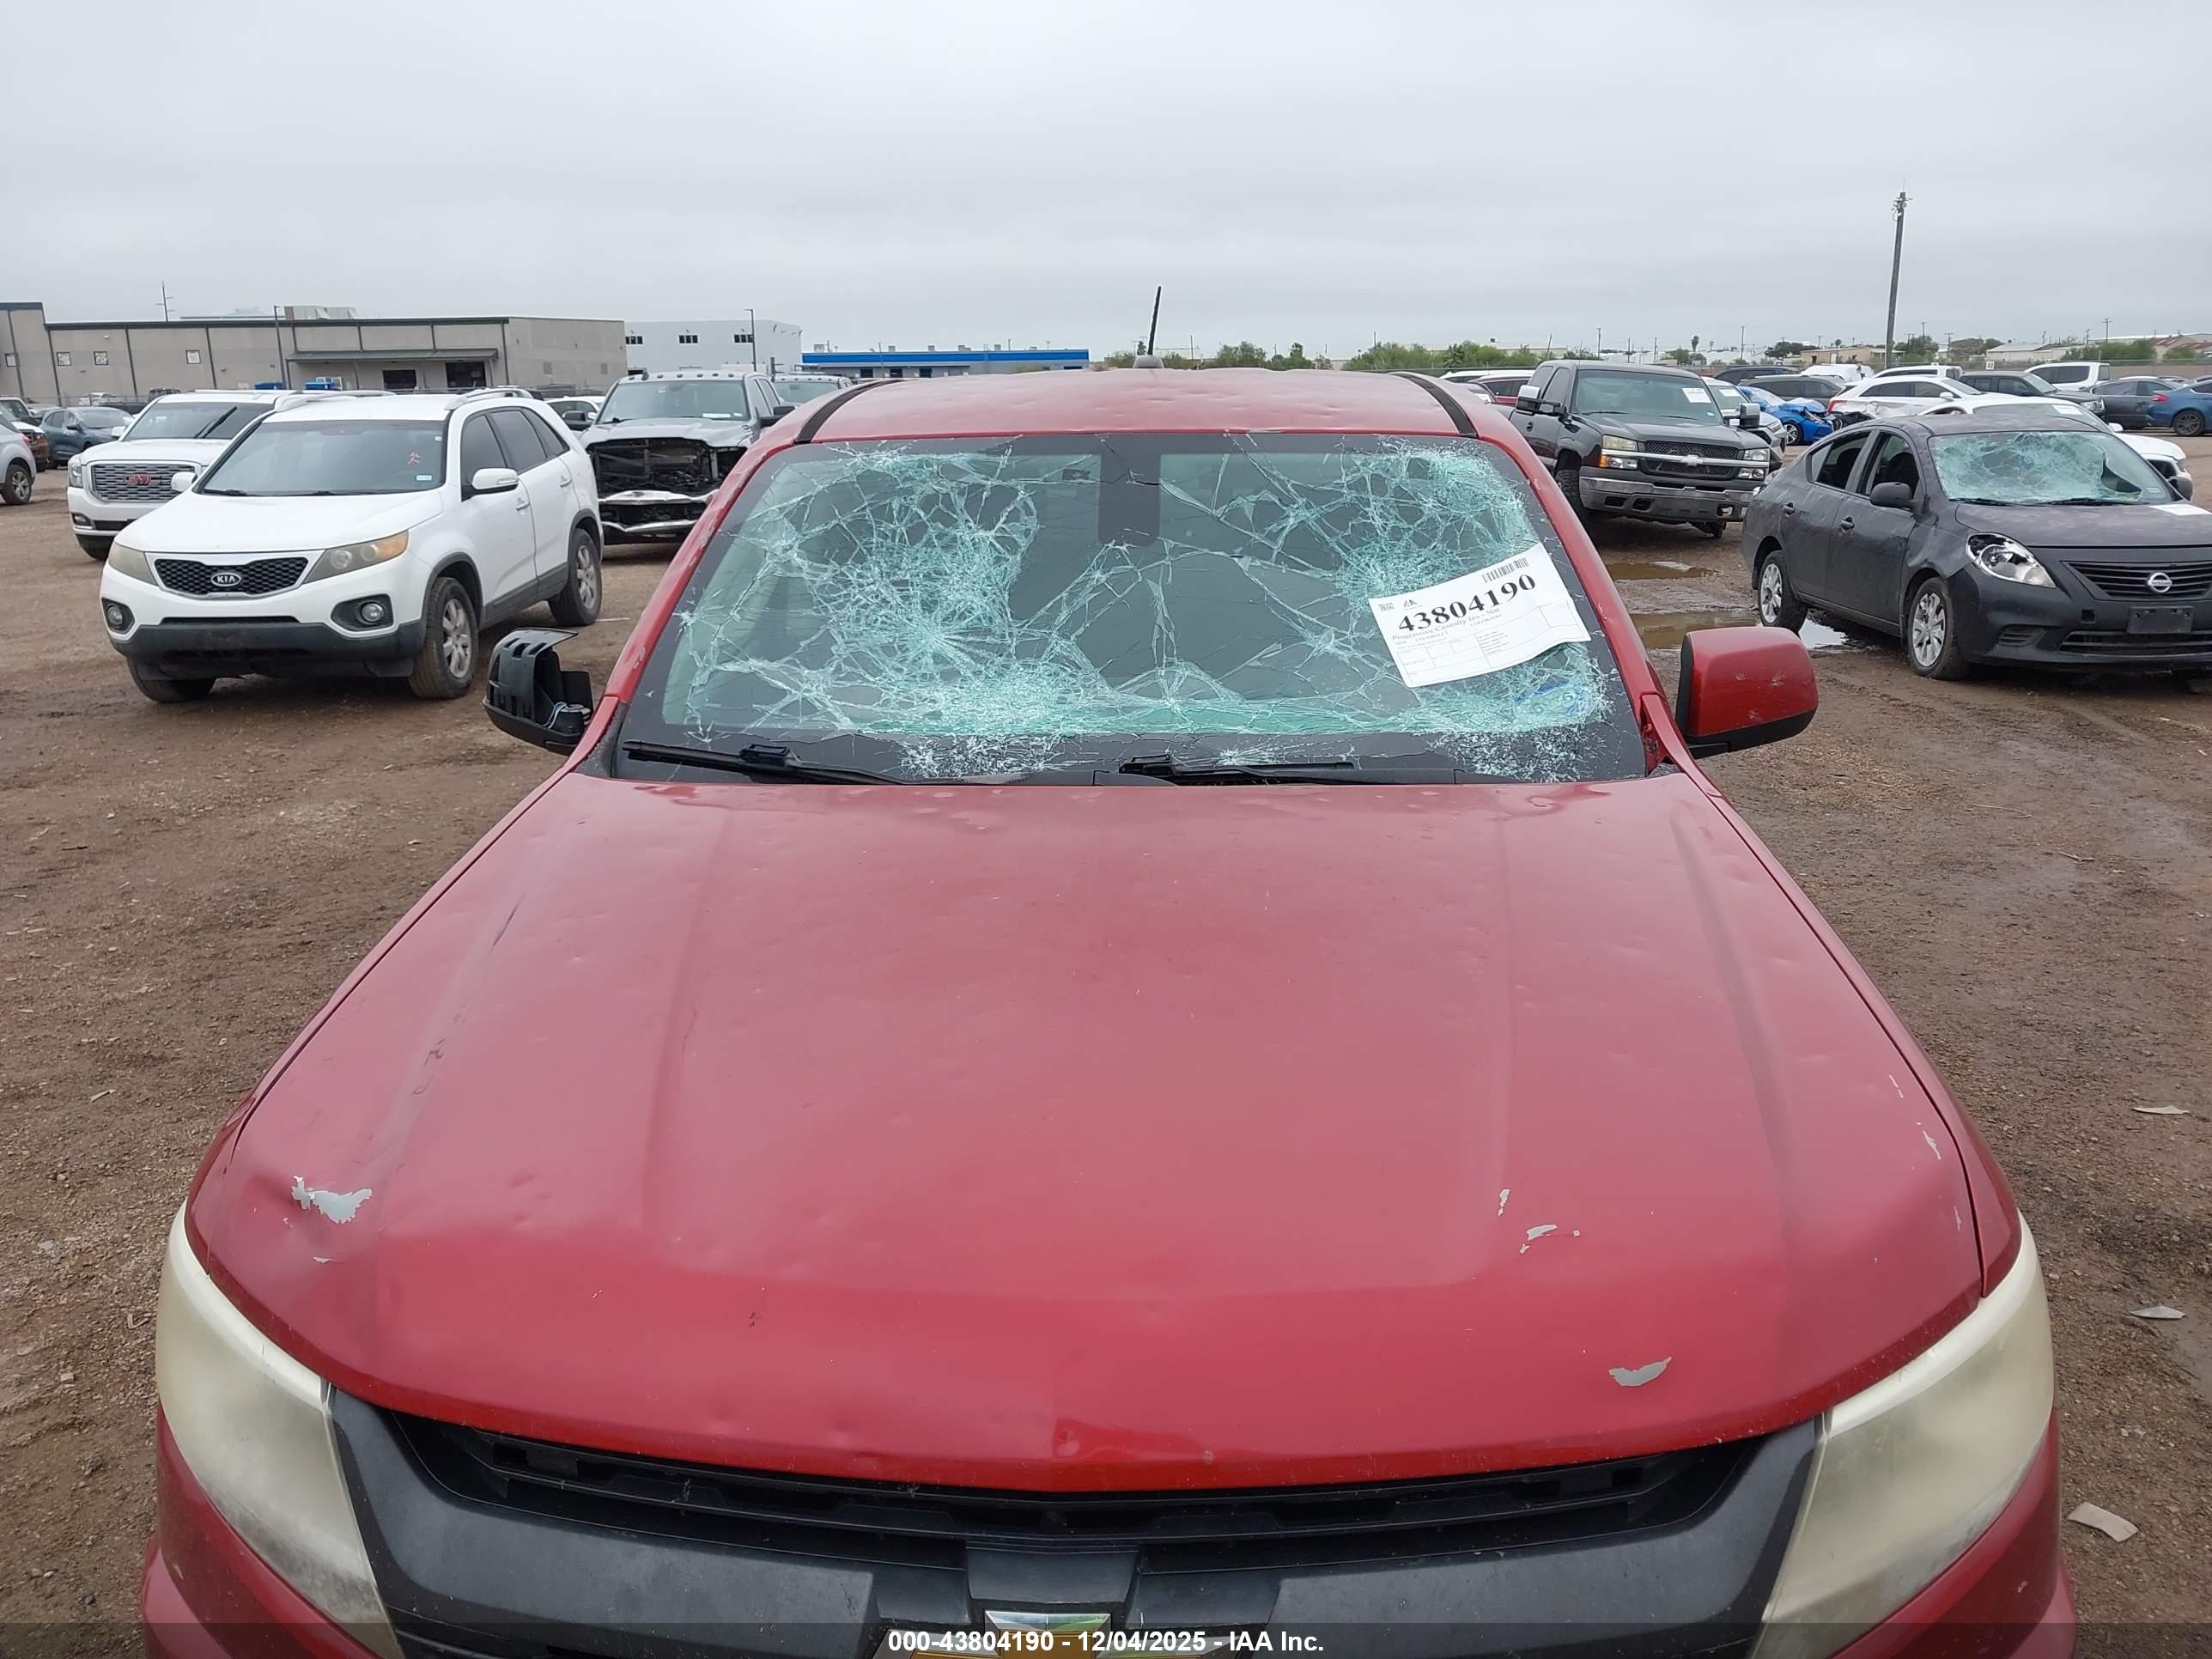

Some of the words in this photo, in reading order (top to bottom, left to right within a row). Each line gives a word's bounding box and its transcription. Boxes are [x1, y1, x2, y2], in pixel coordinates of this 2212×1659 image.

[1399, 574, 1536, 631] 43804190
[1392, 628, 1434, 641] Progressive
[1435, 619, 1467, 632] Casualty
